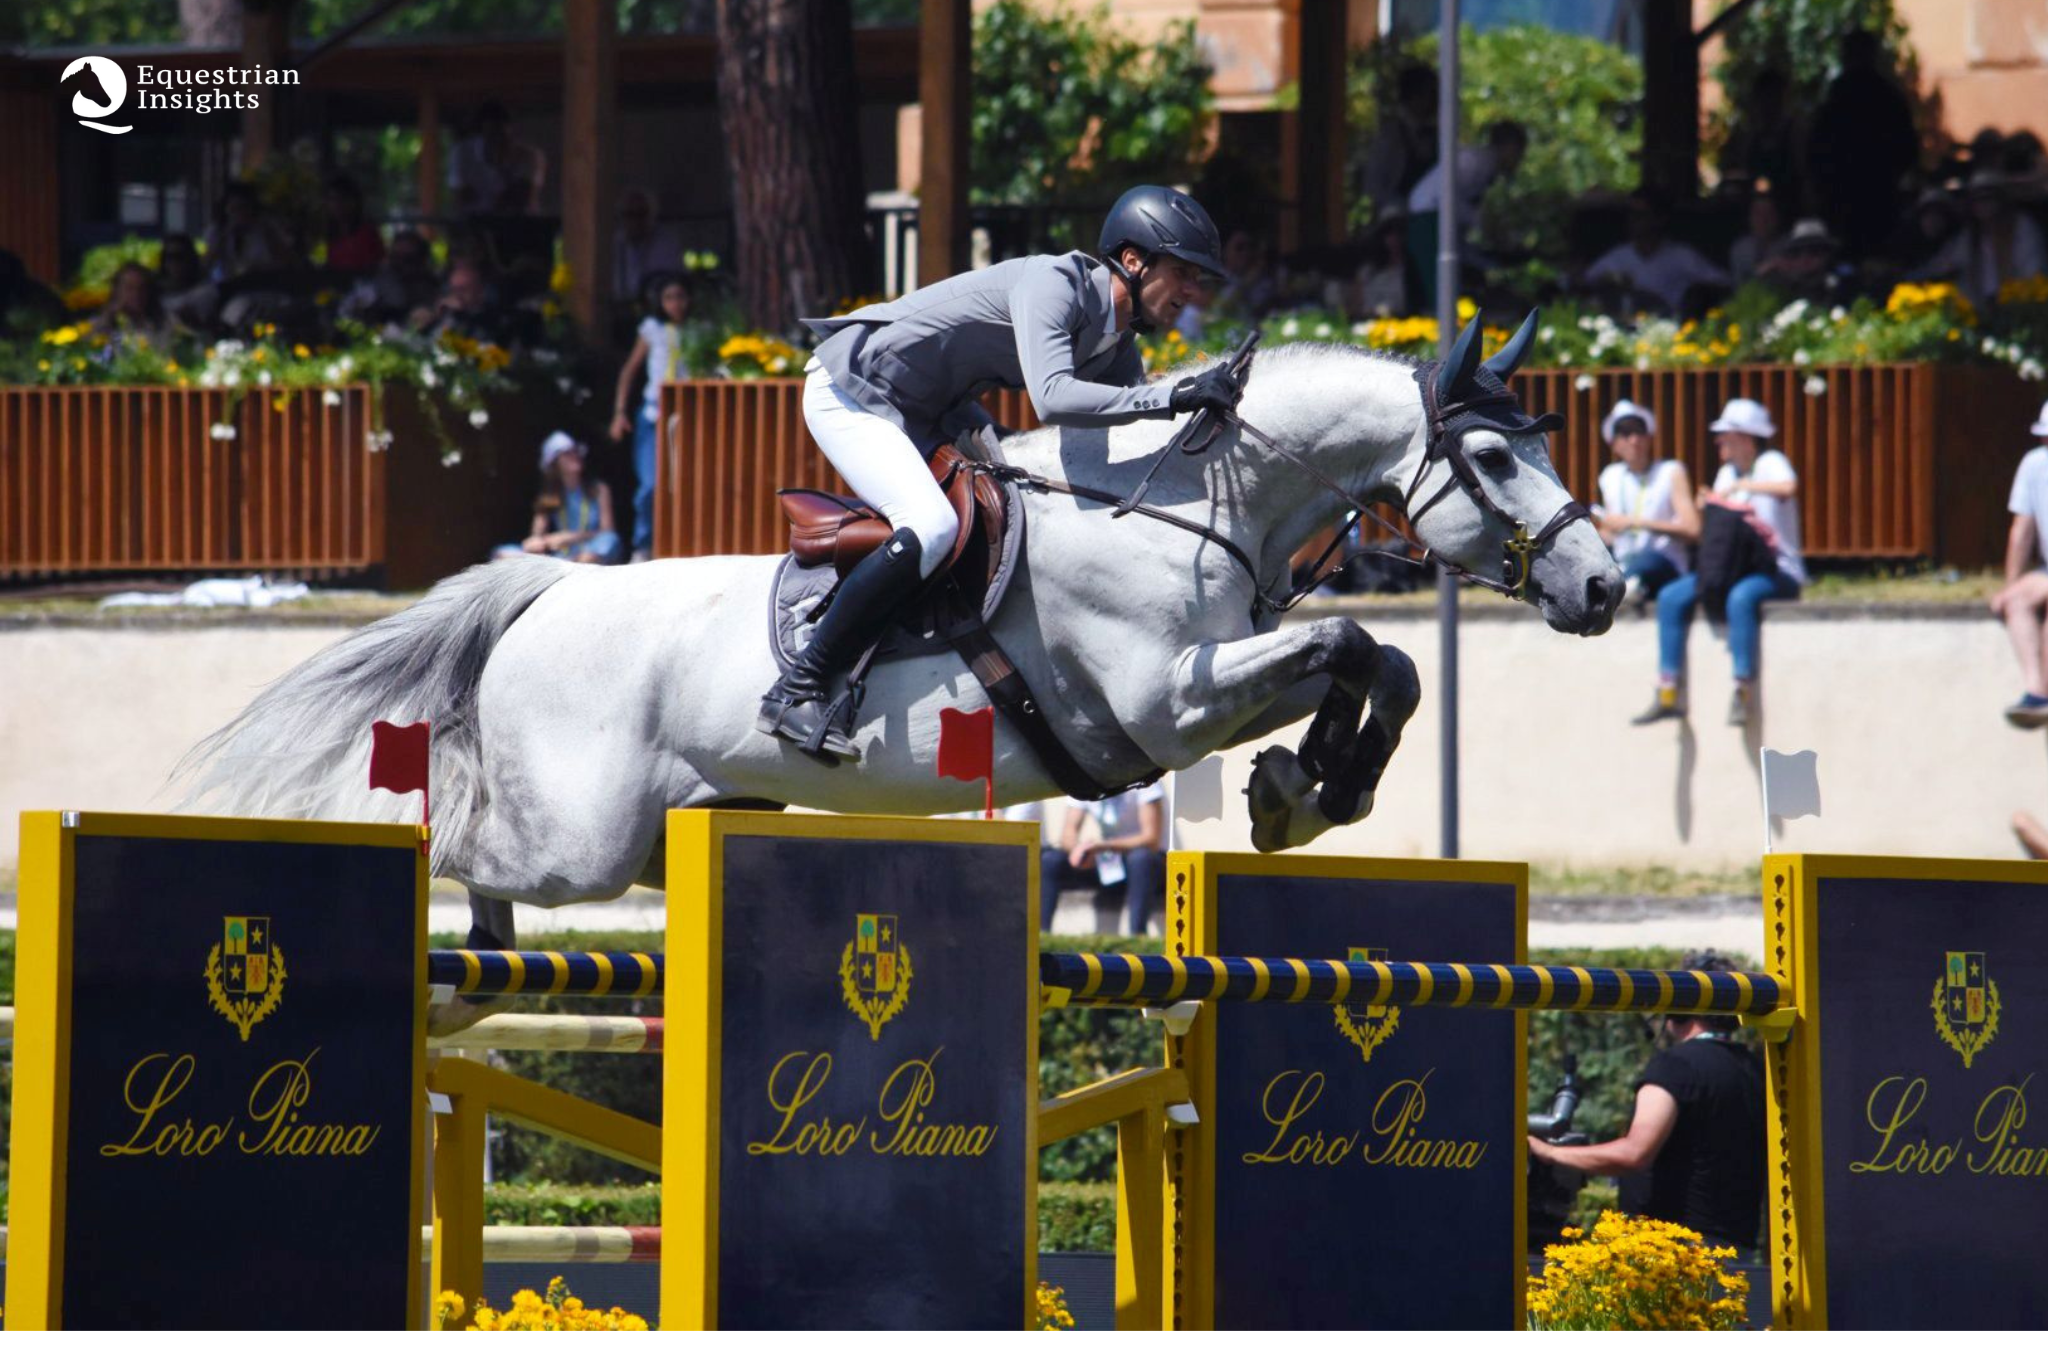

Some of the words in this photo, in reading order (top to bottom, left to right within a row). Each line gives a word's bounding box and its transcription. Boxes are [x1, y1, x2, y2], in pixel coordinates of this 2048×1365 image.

[100, 1053, 234, 1157] Loro
[239, 1047, 382, 1157] Piana
[747, 1051, 866, 1156] Loro
[871, 1045, 998, 1157] Piana
[1242, 1069, 1359, 1165] Loro
[1363, 1067, 1488, 1169] Piana
[1849, 1076, 1962, 1174] Loro
